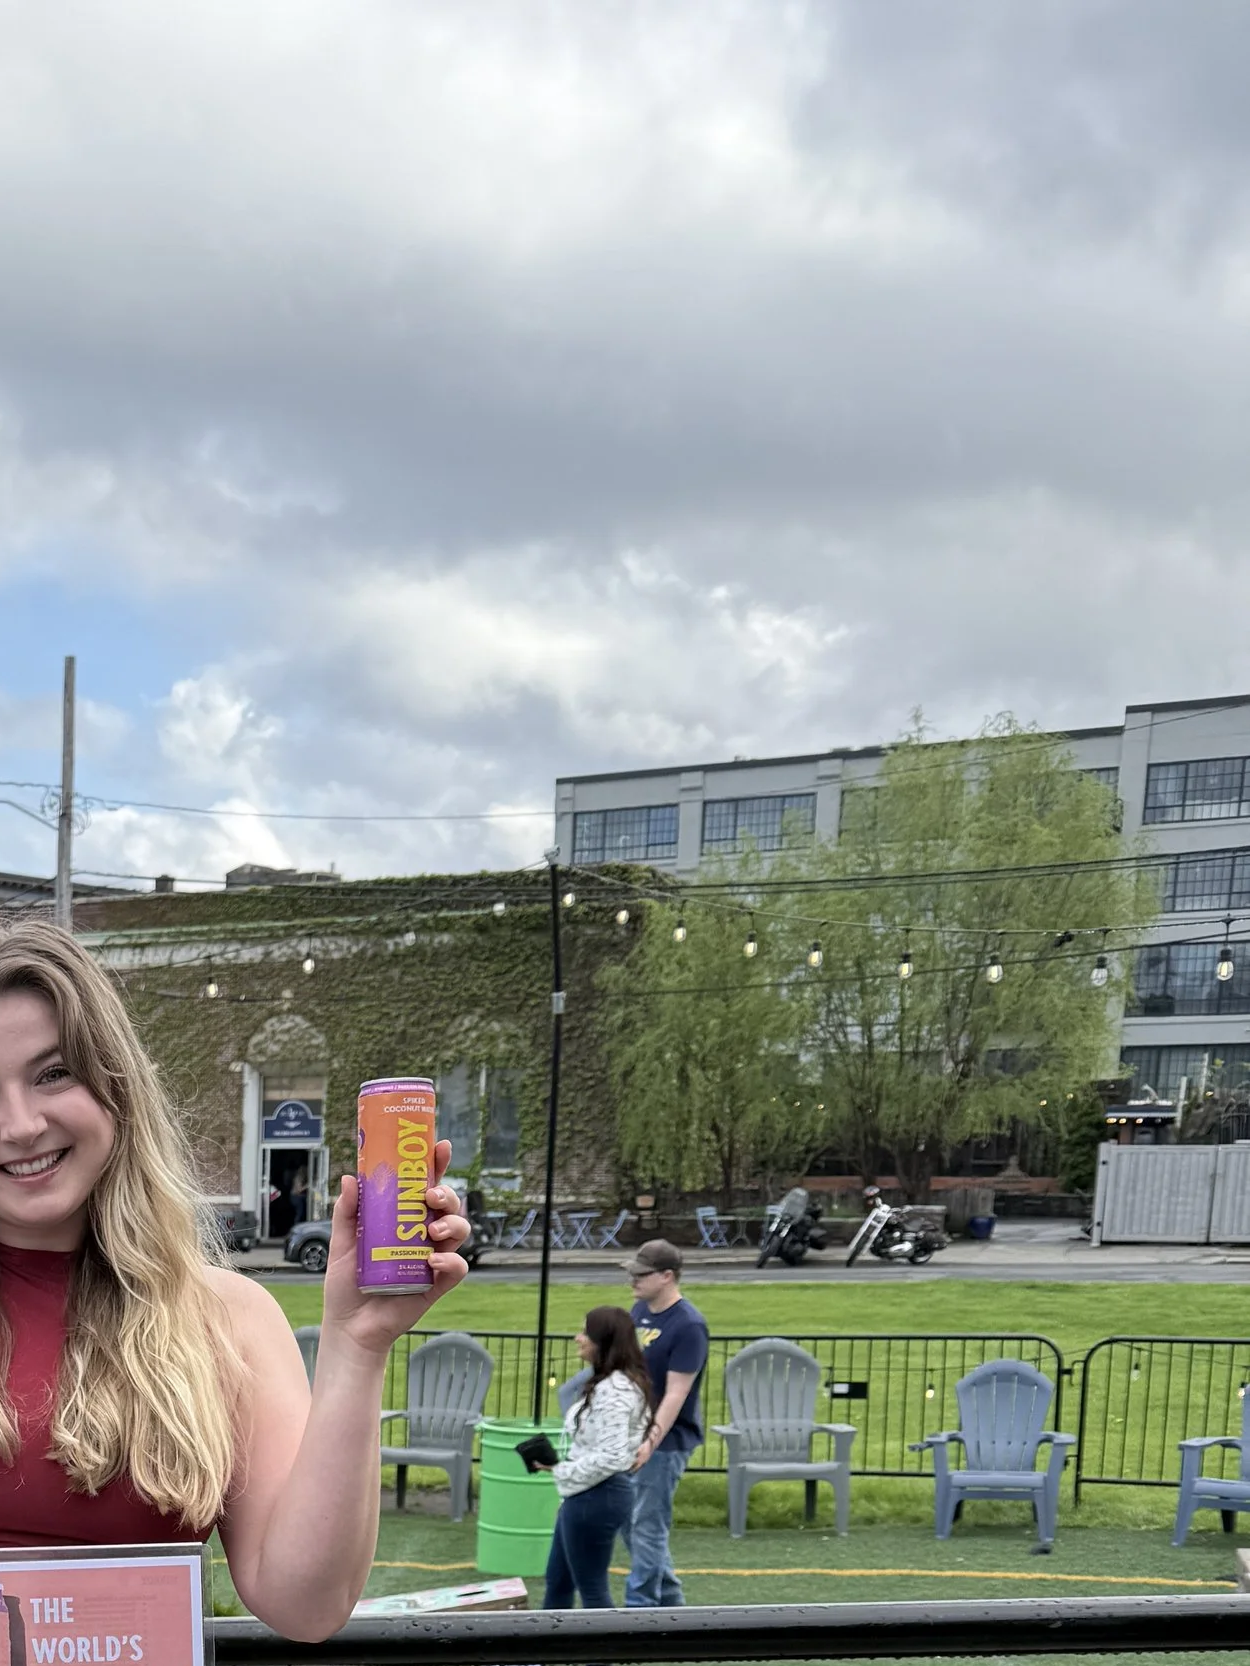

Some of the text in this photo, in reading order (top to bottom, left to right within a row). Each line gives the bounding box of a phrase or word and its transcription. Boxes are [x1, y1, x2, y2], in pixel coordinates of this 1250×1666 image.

[397, 1118, 428, 1241] SUNBOY
[30, 1597, 74, 1624] THE
[32, 1635, 144, 1664] WORLD'S
